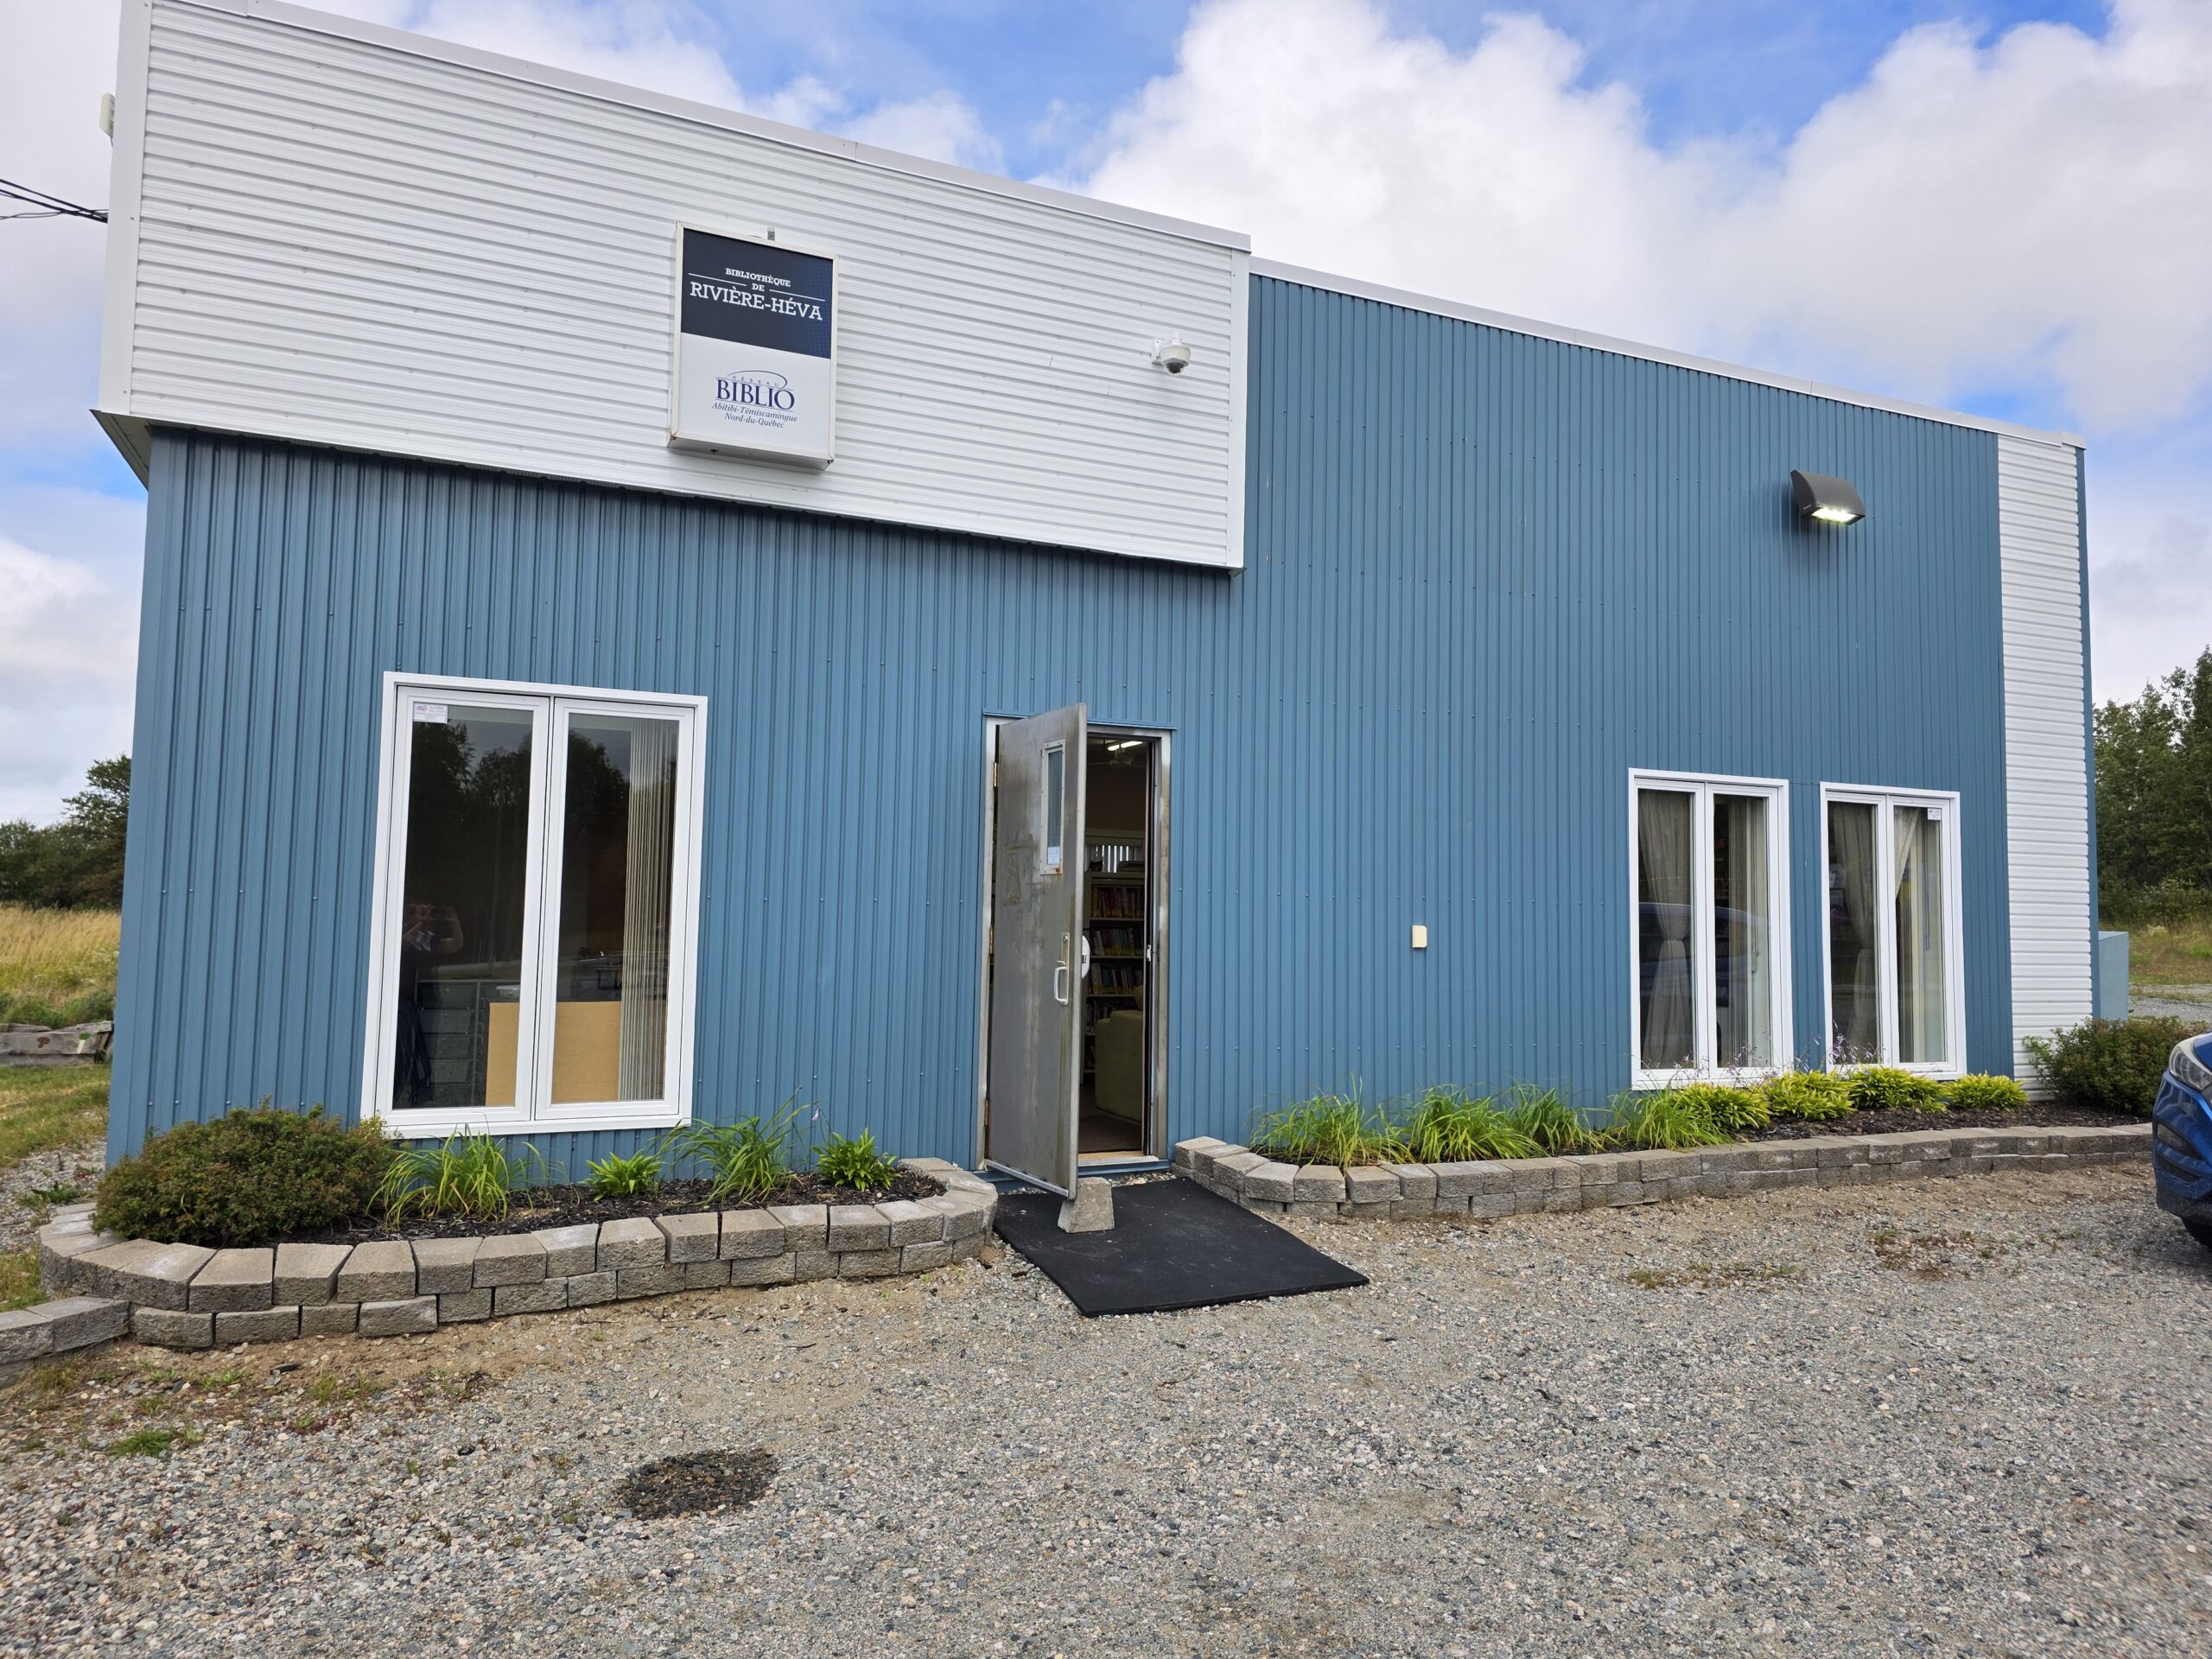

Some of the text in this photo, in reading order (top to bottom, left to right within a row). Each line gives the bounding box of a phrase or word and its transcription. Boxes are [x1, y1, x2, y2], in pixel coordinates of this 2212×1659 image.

[726, 268, 791, 287] BIBLIOTHÈQUE
[752, 283, 766, 292] DE
[690, 282, 823, 321] RIVIÈRE-HÉVA
[716, 378, 795, 410] BIBLIO
[712, 402, 798, 422] Abitibi-Témiscamingue
[724, 412, 785, 429] Nord-du-Québec
